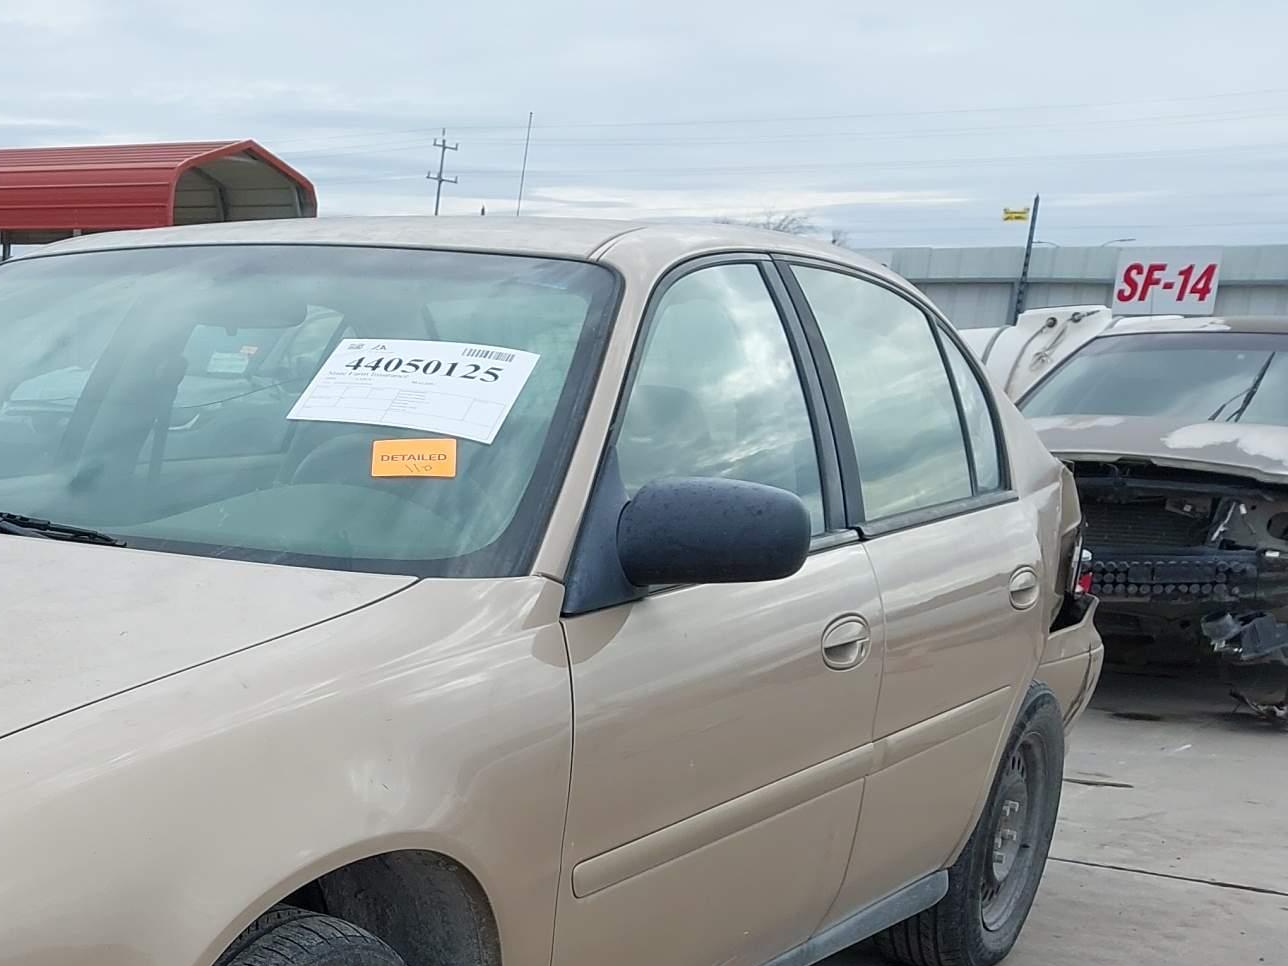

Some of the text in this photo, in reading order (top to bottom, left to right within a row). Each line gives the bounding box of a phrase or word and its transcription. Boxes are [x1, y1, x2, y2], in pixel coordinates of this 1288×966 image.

[1116, 263, 1218, 302] SF-14
[344, 355, 504, 384] 44050125
[380, 453, 448, 462] DETAILED
